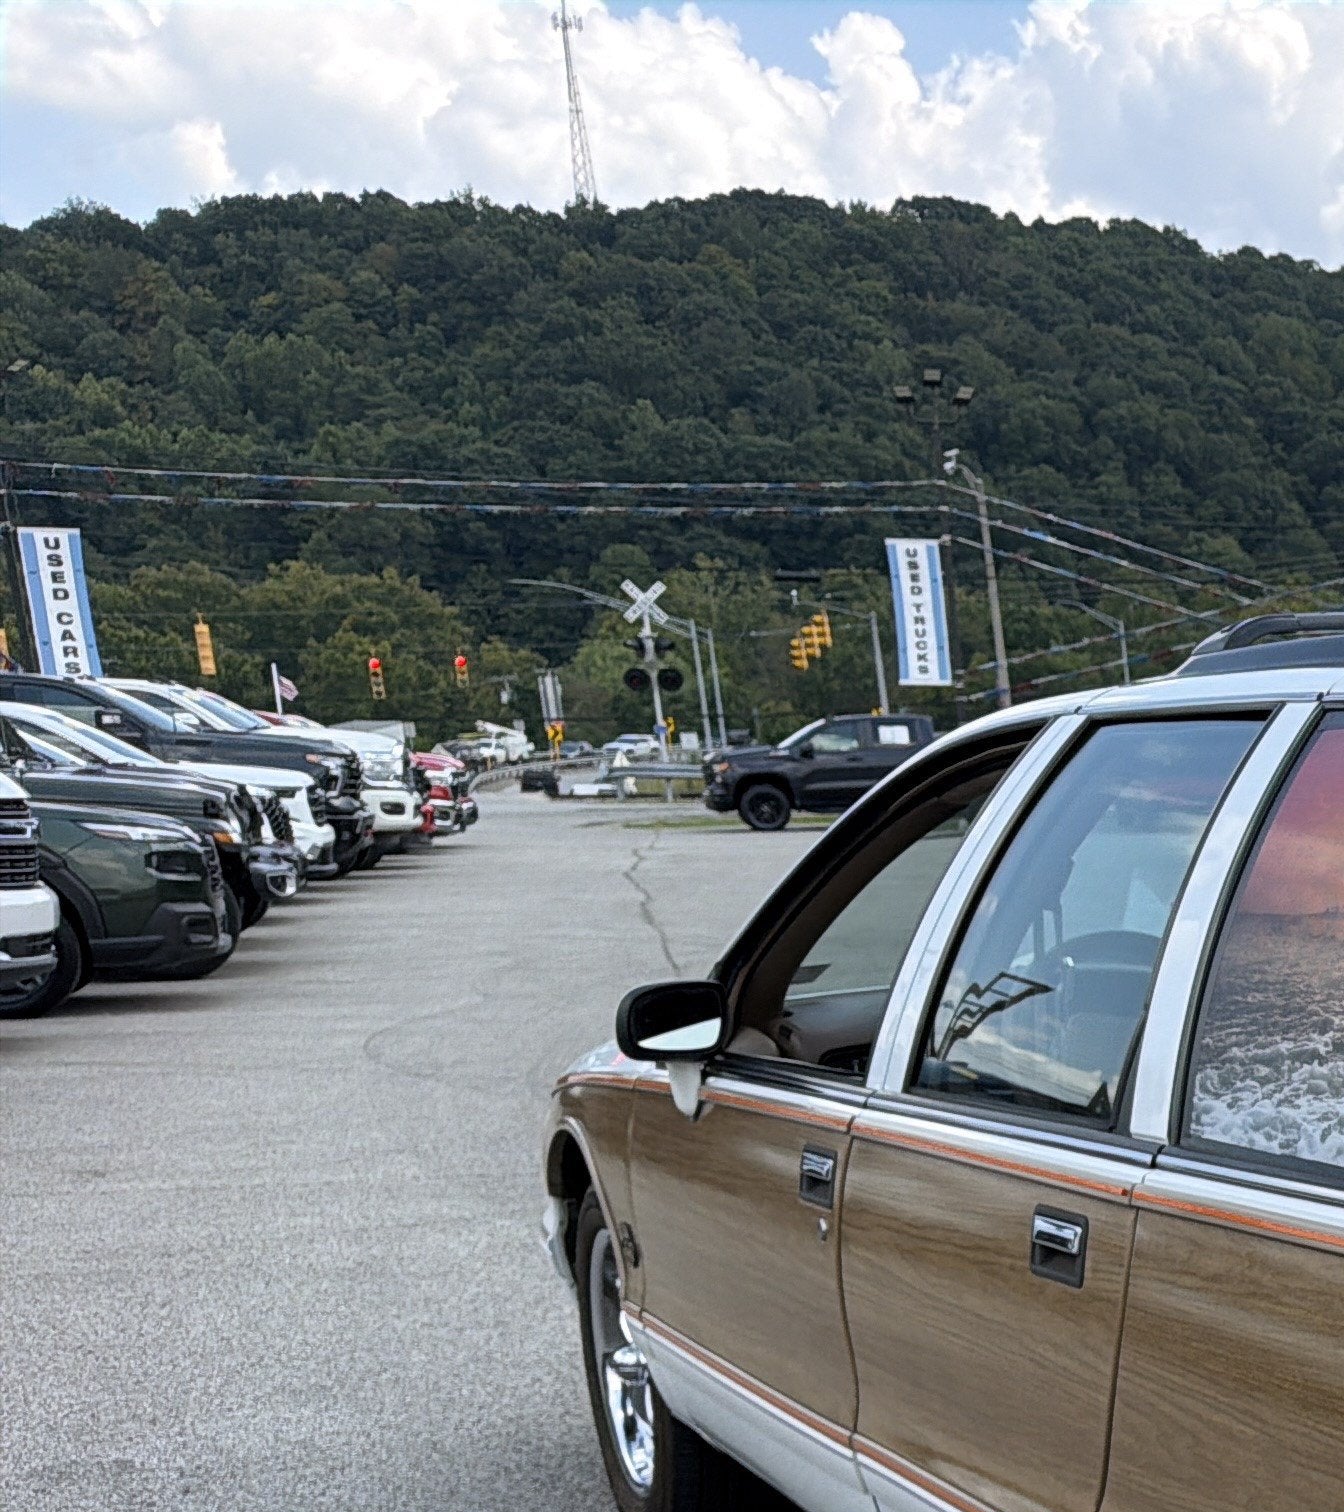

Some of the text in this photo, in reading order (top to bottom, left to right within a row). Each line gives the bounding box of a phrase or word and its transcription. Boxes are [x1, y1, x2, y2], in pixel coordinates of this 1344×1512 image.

[43, 537, 81, 674] USED CARS
[905, 547, 929, 675] USED TRUCKS
